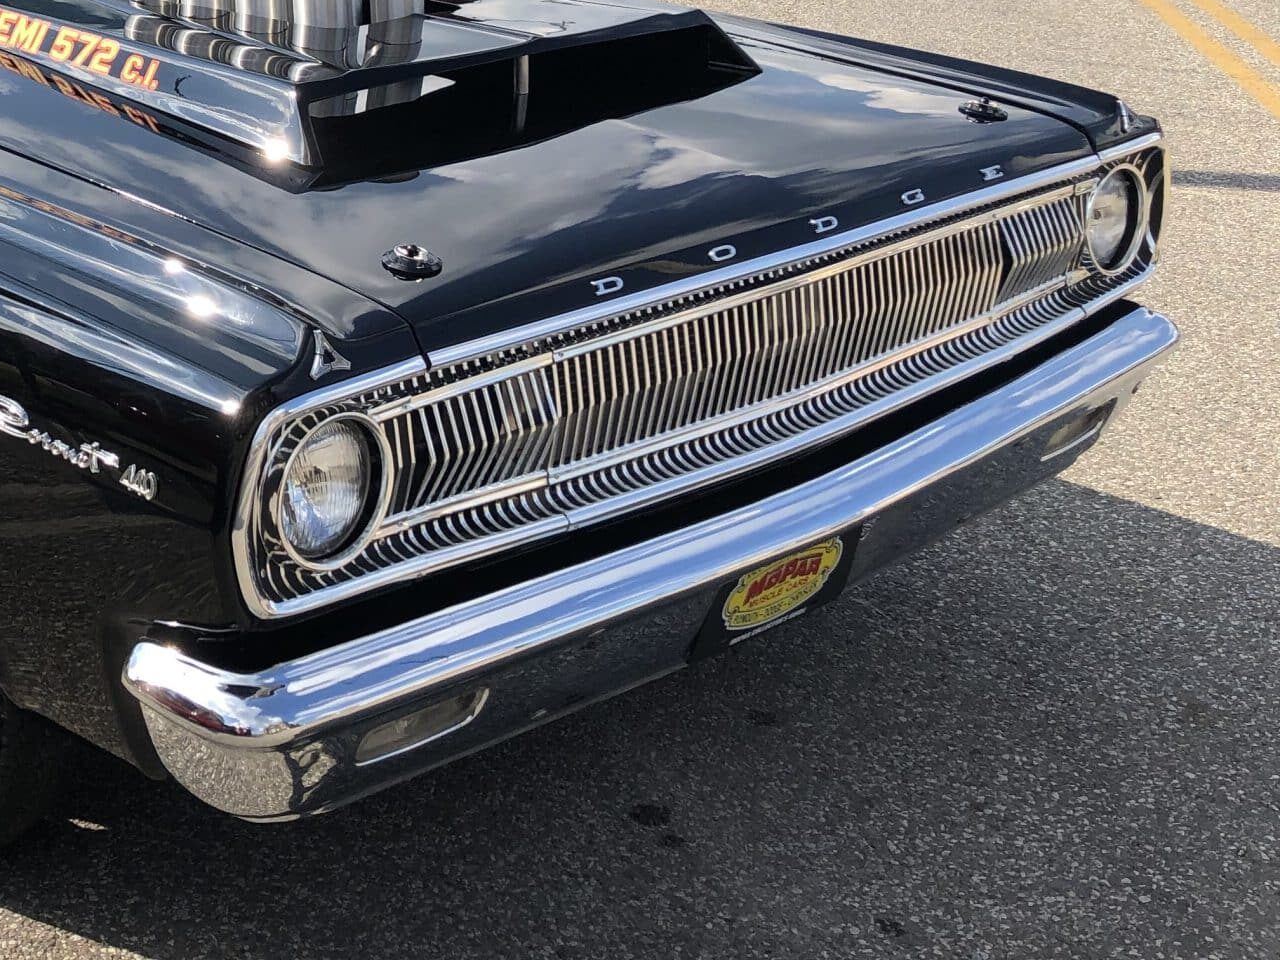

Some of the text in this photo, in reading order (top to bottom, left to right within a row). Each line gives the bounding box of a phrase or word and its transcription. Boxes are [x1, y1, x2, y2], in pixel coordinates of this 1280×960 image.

[48, 26, 121, 76] 572
[590, 164, 1006, 296] DODGE
[119, 463, 158, 501] 440
[743, 552, 824, 607] MOPAR
